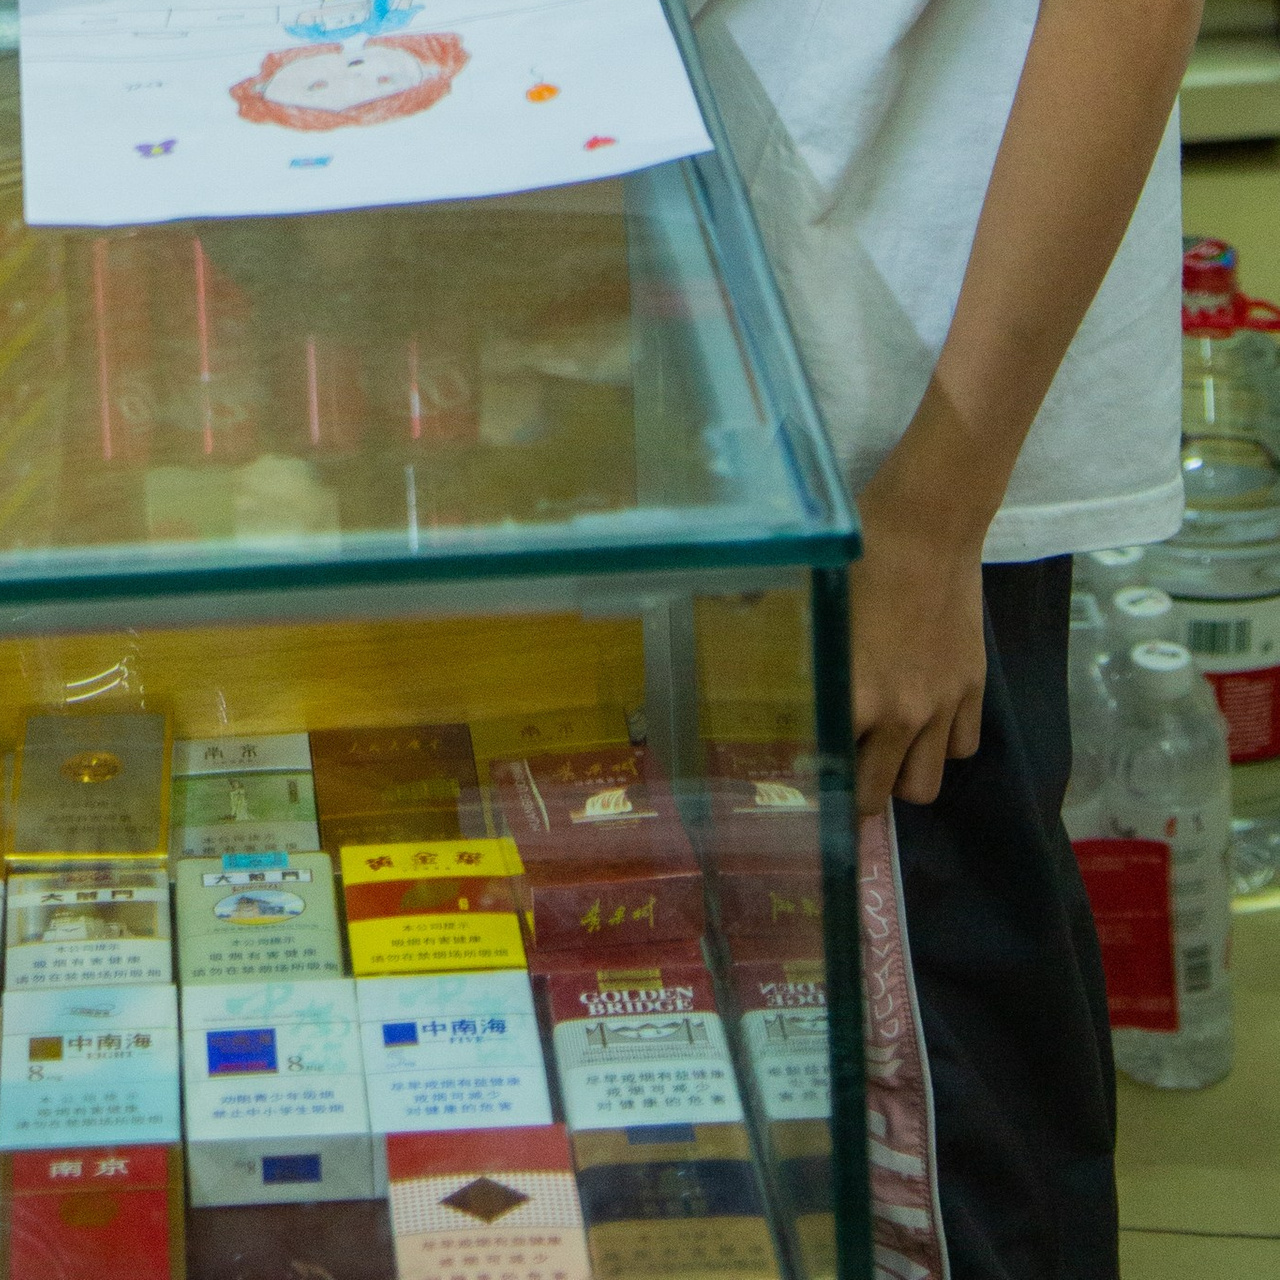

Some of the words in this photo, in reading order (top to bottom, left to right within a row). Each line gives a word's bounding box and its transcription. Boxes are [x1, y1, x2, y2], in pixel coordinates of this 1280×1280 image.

[579, 985, 694, 1006] GOLDEN
[588, 999, 694, 1017] BRIDGE
[421, 1018, 508, 1038] 中南海
[67, 1031, 153, 1051] 中南海
[49, 1157, 130, 1178] 南京
